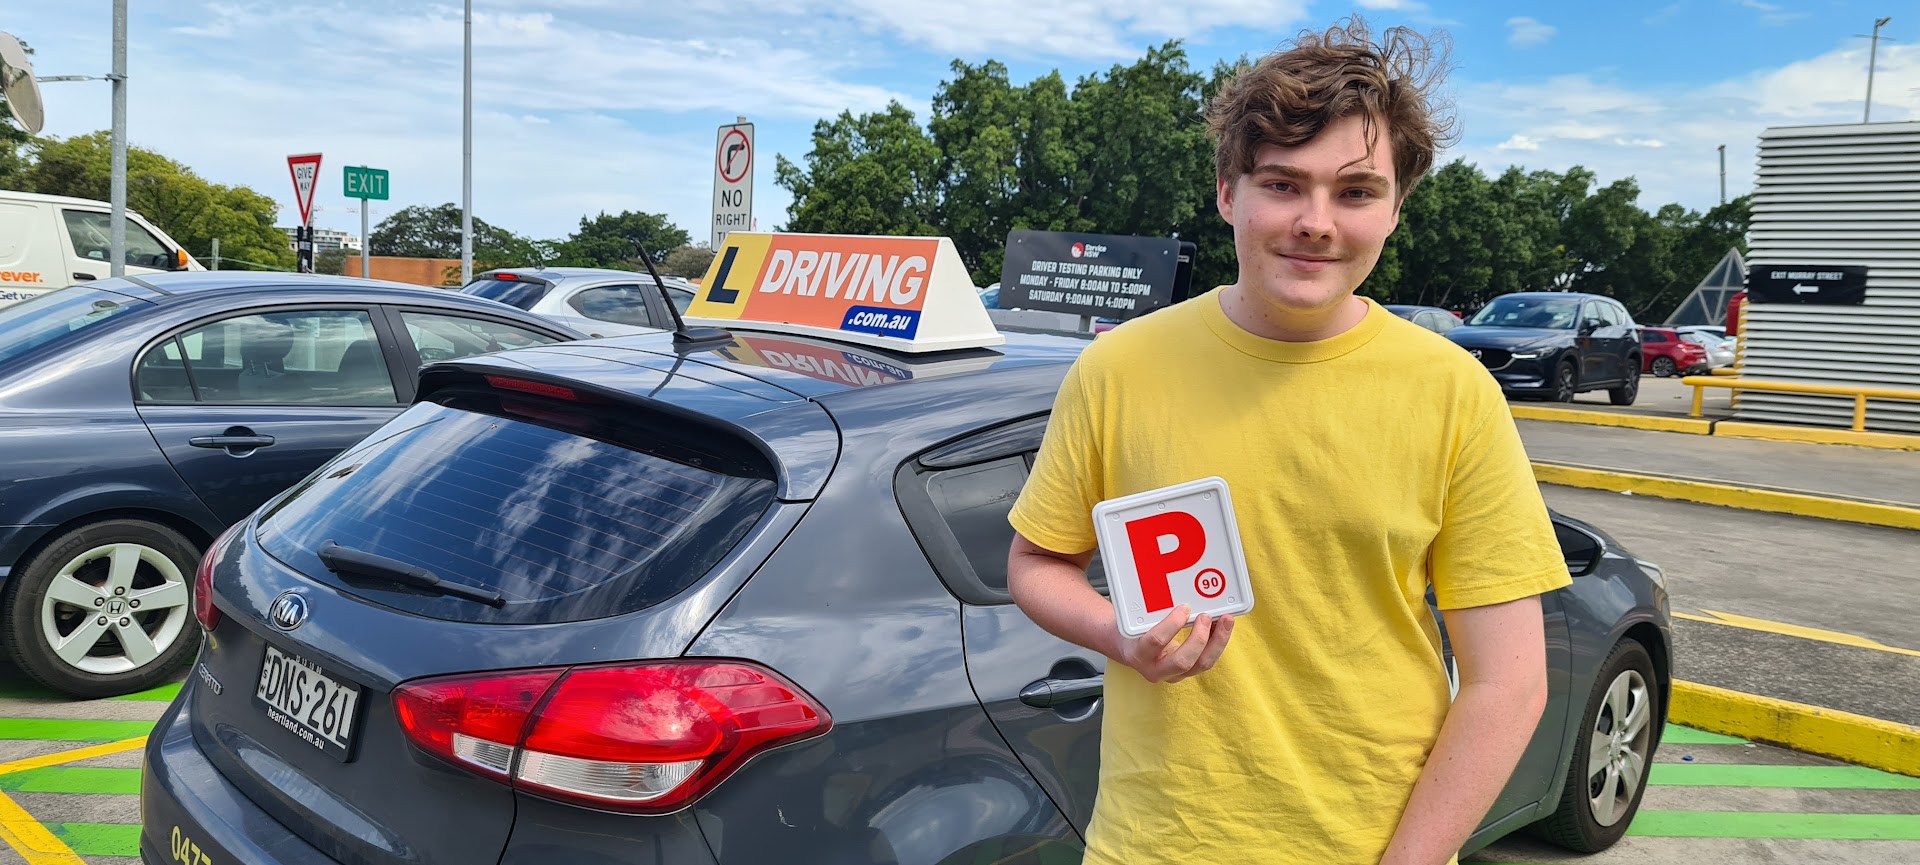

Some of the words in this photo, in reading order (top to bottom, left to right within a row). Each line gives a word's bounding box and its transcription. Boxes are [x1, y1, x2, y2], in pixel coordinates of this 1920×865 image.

[297, 167, 313, 179] GIVE
[300, 182, 310, 191] WAY
[347, 172, 385, 194] EXIT
[721, 189, 743, 208] NO
[716, 213, 747, 226] RIGHT
[1083, 250, 1101, 258] NSW
[1085, 243, 1107, 253] Service
[0, 271, 44, 282] ever.
[706, 246, 740, 304] L
[758, 249, 928, 306] DRIVING
[1031, 260, 1057, 273] DRIVER
[1058, 262, 1087, 276] TESTING
[1088, 264, 1121, 278] PARKING
[1122, 267, 1143, 280] ONLY
[1770, 270, 1787, 280] EXIT
[1787, 271, 1816, 280] MURRAY
[1816, 271, 1844, 280] STREET
[1020, 274, 1049, 287] MONDAY
[1053, 276, 1080, 290] FRIDAY
[1080, 279, 1109, 293] 8:00AM
[1110, 282, 1121, 294] TO
[1121, 283, 1152, 297] 5:00PM
[1028, 289, 1063, 303] SATURDAY
[1065, 292, 1094, 306] 9:00AM
[1094, 295, 1105, 307] TO
[1105, 296, 1136, 310] 4:00PM
[847, 310, 912, 330] .com.au
[1124, 511, 1207, 614] P
[1202, 576, 1219, 590] 90
[273, 599, 300, 625] KIA
[267, 706, 325, 750] heartland.com.au
